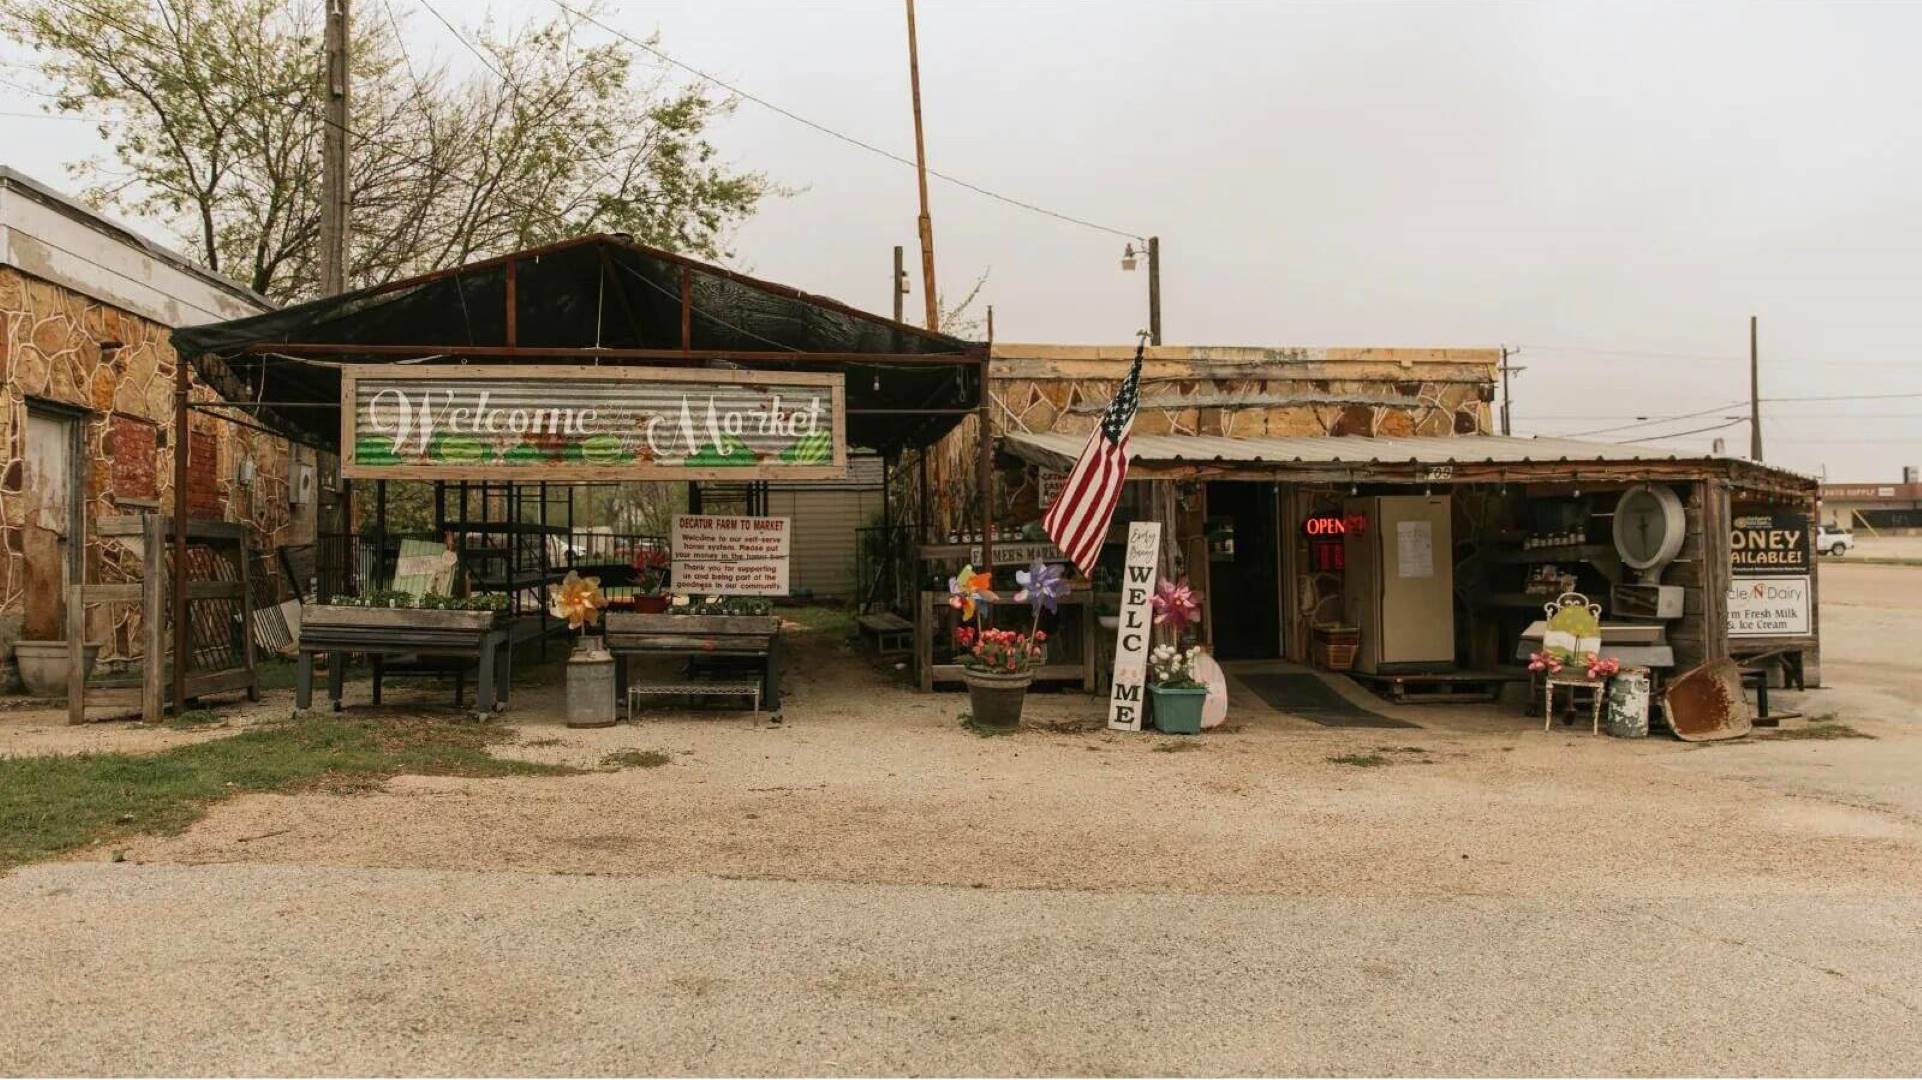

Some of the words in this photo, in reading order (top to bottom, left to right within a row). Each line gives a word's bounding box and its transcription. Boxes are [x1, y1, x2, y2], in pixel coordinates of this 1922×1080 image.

[369, 388, 598, 457] Welcome
[647, 393, 826, 457] Market
[679, 518, 712, 529] DECATUR
[716, 519, 737, 530] FARM
[741, 520, 750, 530] TO
[753, 520, 785, 531] MARKET
[1307, 518, 1344, 534] OPEN
[1730, 530, 1800, 549] ONEY
[739, 544, 764, 552] Please
[732, 552, 743, 560] the
[1730, 551, 1802, 564] AILABLE!
[683, 563, 706, 571] Thank
[737, 565, 777, 574] supporting
[711, 573, 733, 582] being
[735, 573, 751, 582] part
[676, 581, 712, 589] goodness
[1767, 587, 1801, 601] Dairy
[1744, 609, 1771, 619] Fresh
[1774, 609, 1798, 618] Milk
[1739, 620, 1753, 629] Ice
[1756, 620, 1788, 629] Cream
